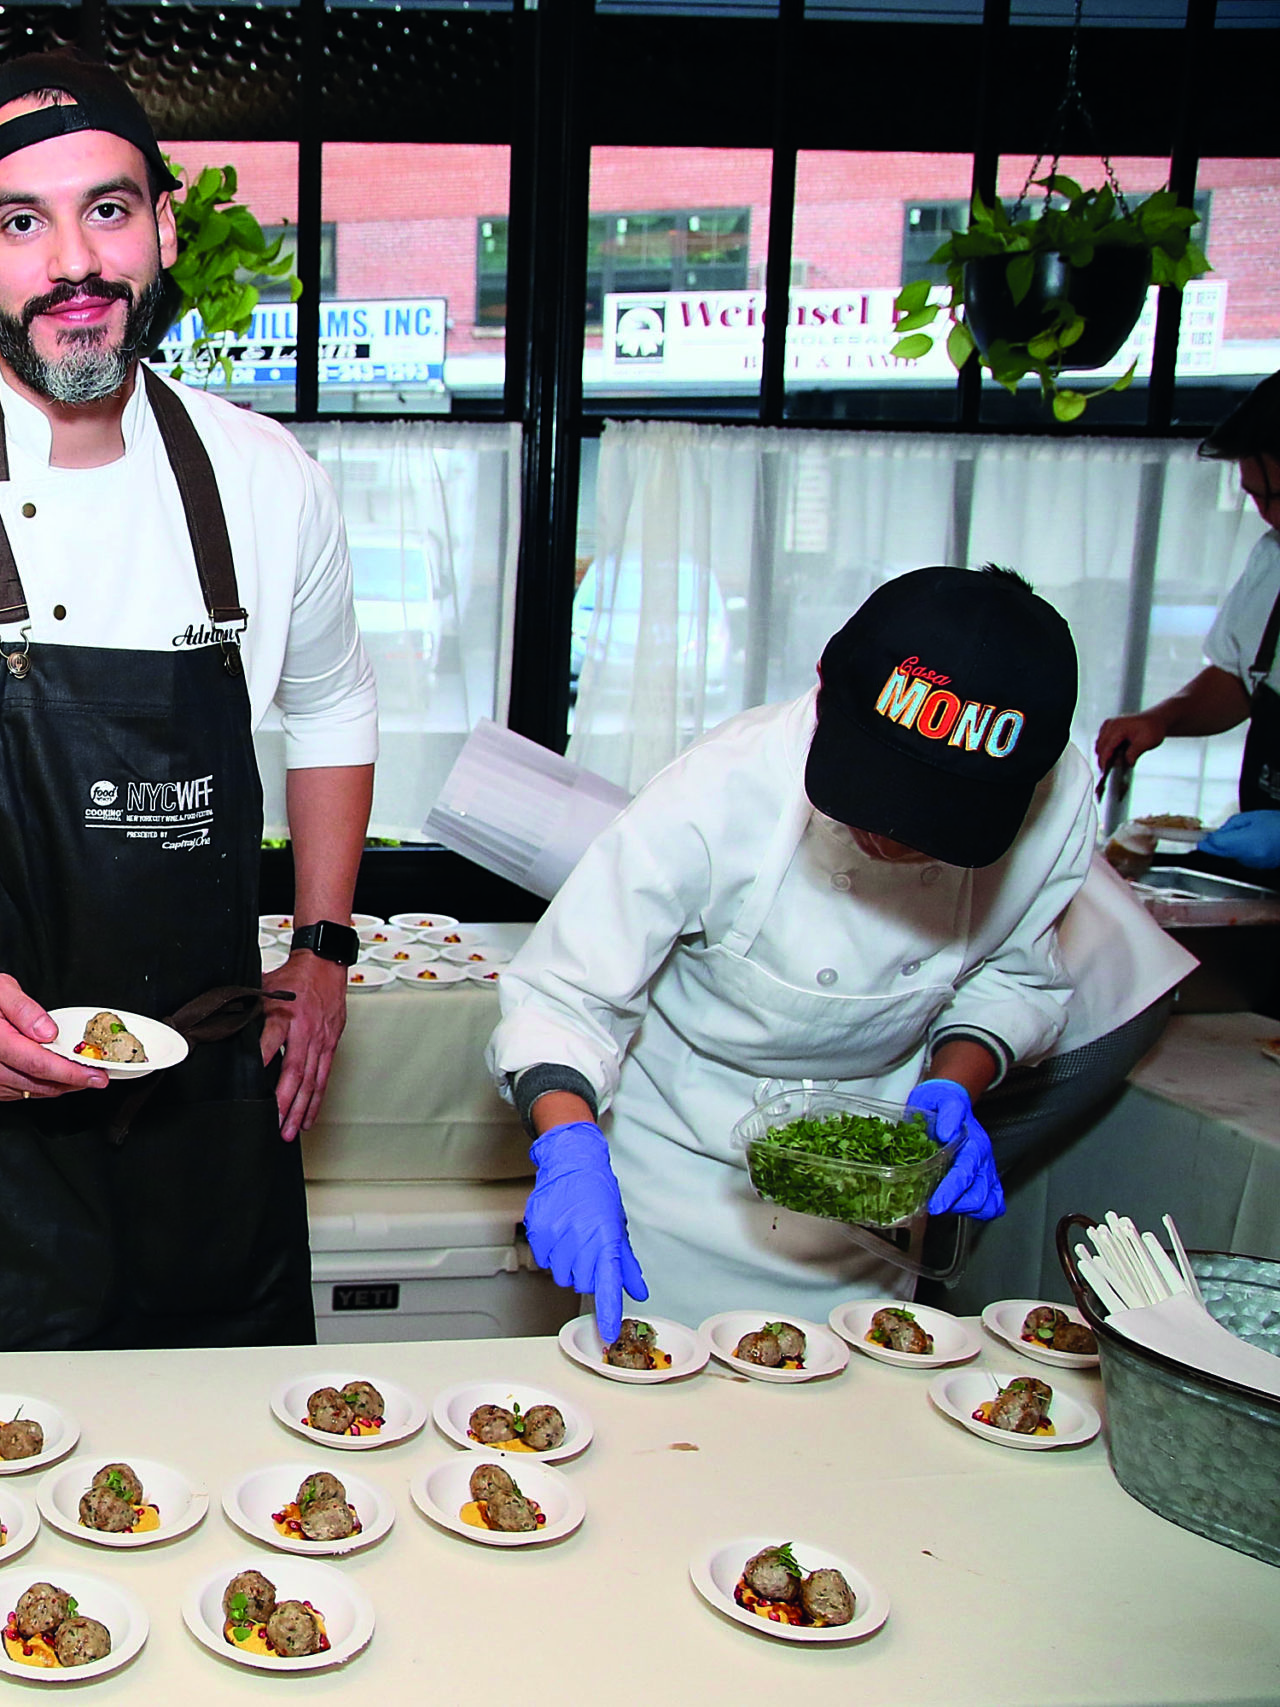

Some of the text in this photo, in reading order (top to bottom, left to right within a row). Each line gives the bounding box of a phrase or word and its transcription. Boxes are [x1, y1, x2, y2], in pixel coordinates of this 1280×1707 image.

[384, 307, 439, 336] INC.
[899, 656, 952, 686] Casa
[873, 666, 1026, 758] MONO
[127, 775, 213, 811] NYCWFF
[85, 808, 122, 817] COOKING
[338, 1289, 394, 1306] YETI
